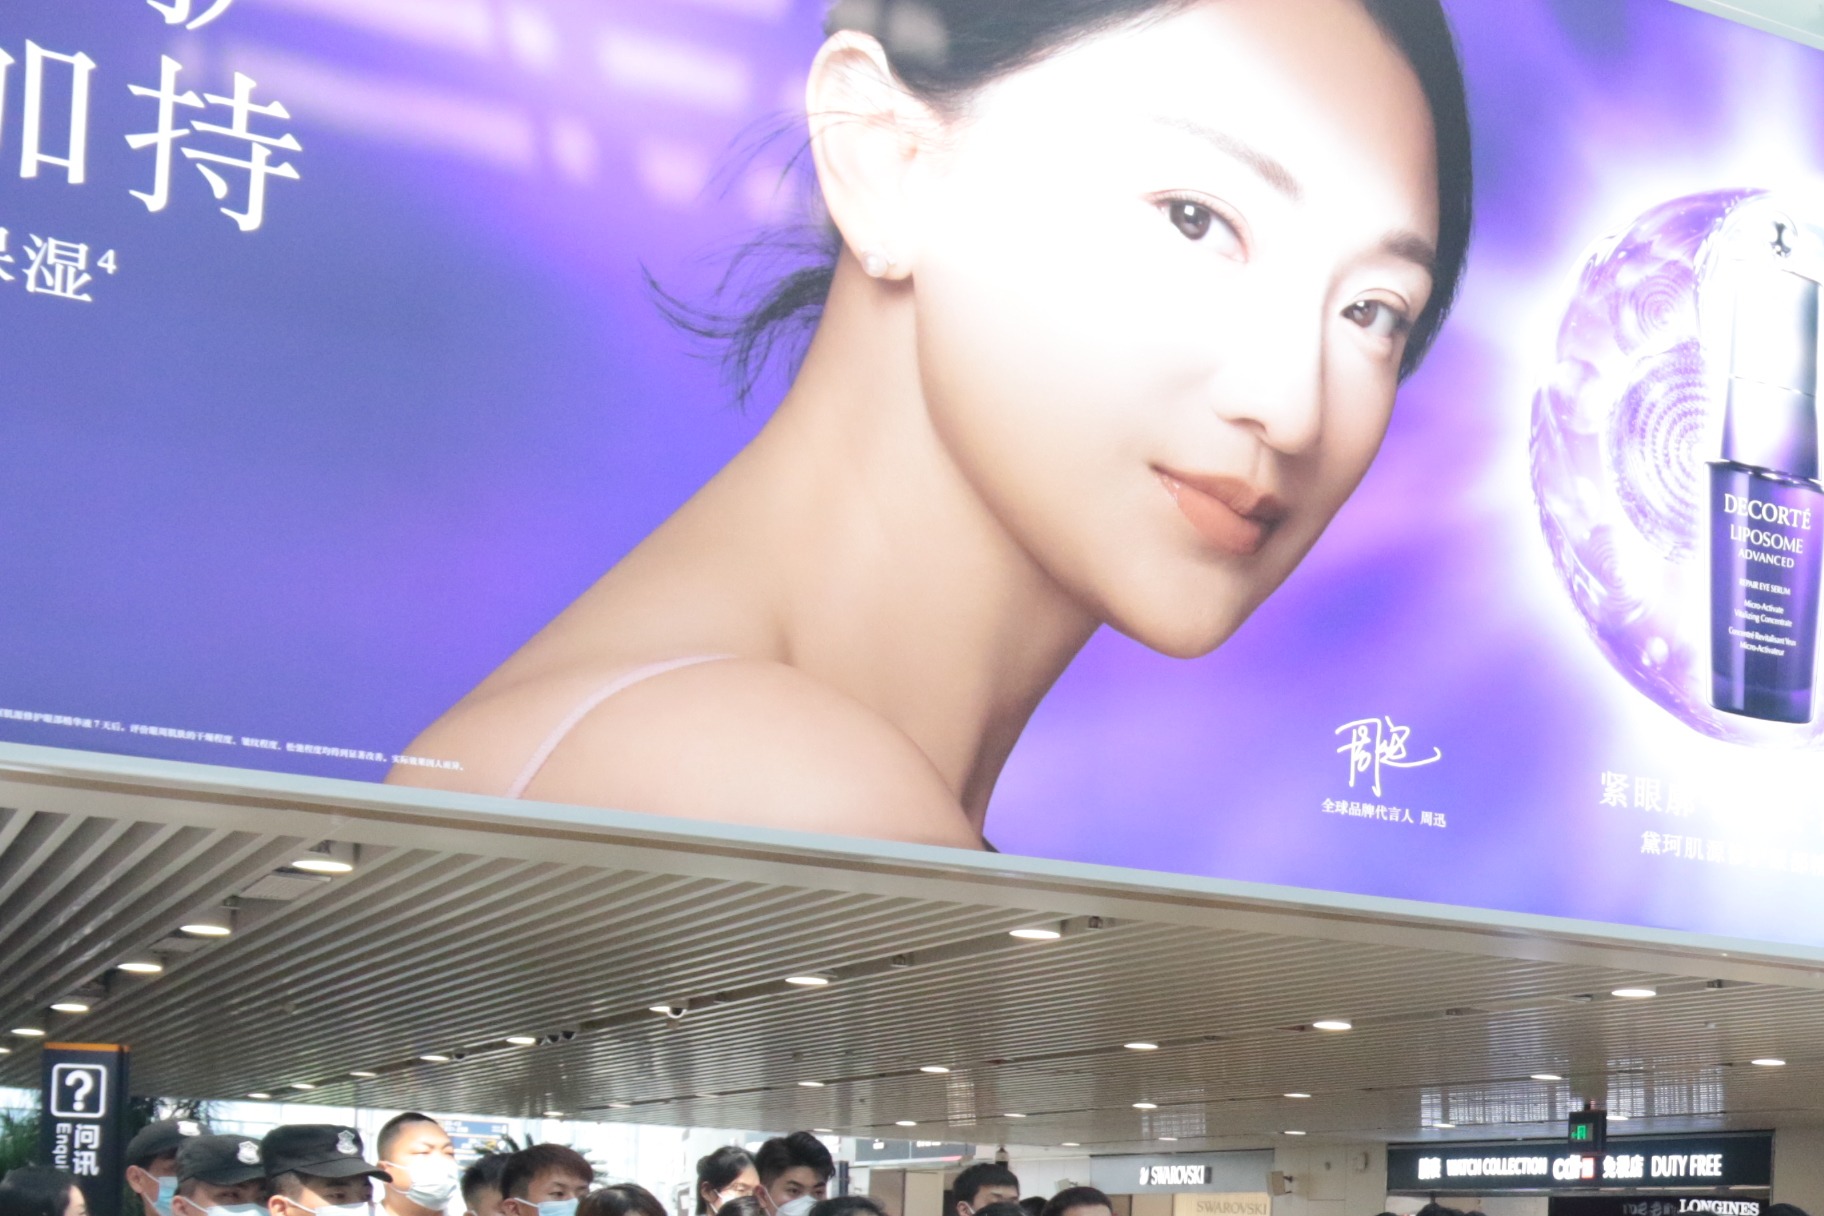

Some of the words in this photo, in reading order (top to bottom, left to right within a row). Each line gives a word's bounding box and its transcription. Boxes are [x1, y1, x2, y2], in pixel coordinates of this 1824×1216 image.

[1724, 493, 1812, 530] DECORTÉ
[1730, 524, 1803, 554] LIPOSOME
[1738, 549, 1794, 568] ADVANCED
[1760, 582, 1770, 592] EYE
[1771, 584, 1791, 595] SERUM
[1321, 798, 1414, 824] 全球品牌代言人
[1420, 811, 1446, 828] 周迅
[53, 1123, 72, 1169] Enqui
[73, 1124, 101, 1176] 问讯
[1151, 1165, 1205, 1184] SWAROVSKI
[1483, 1157, 1547, 1175] COLLECTION
[1652, 1155, 1686, 1176] DUTY
[1690, 1154, 1722, 1176] FREE
[1197, 1201, 1267, 1215] SWAROVSKI
[1680, 1199, 1759, 1216] LONGINES
